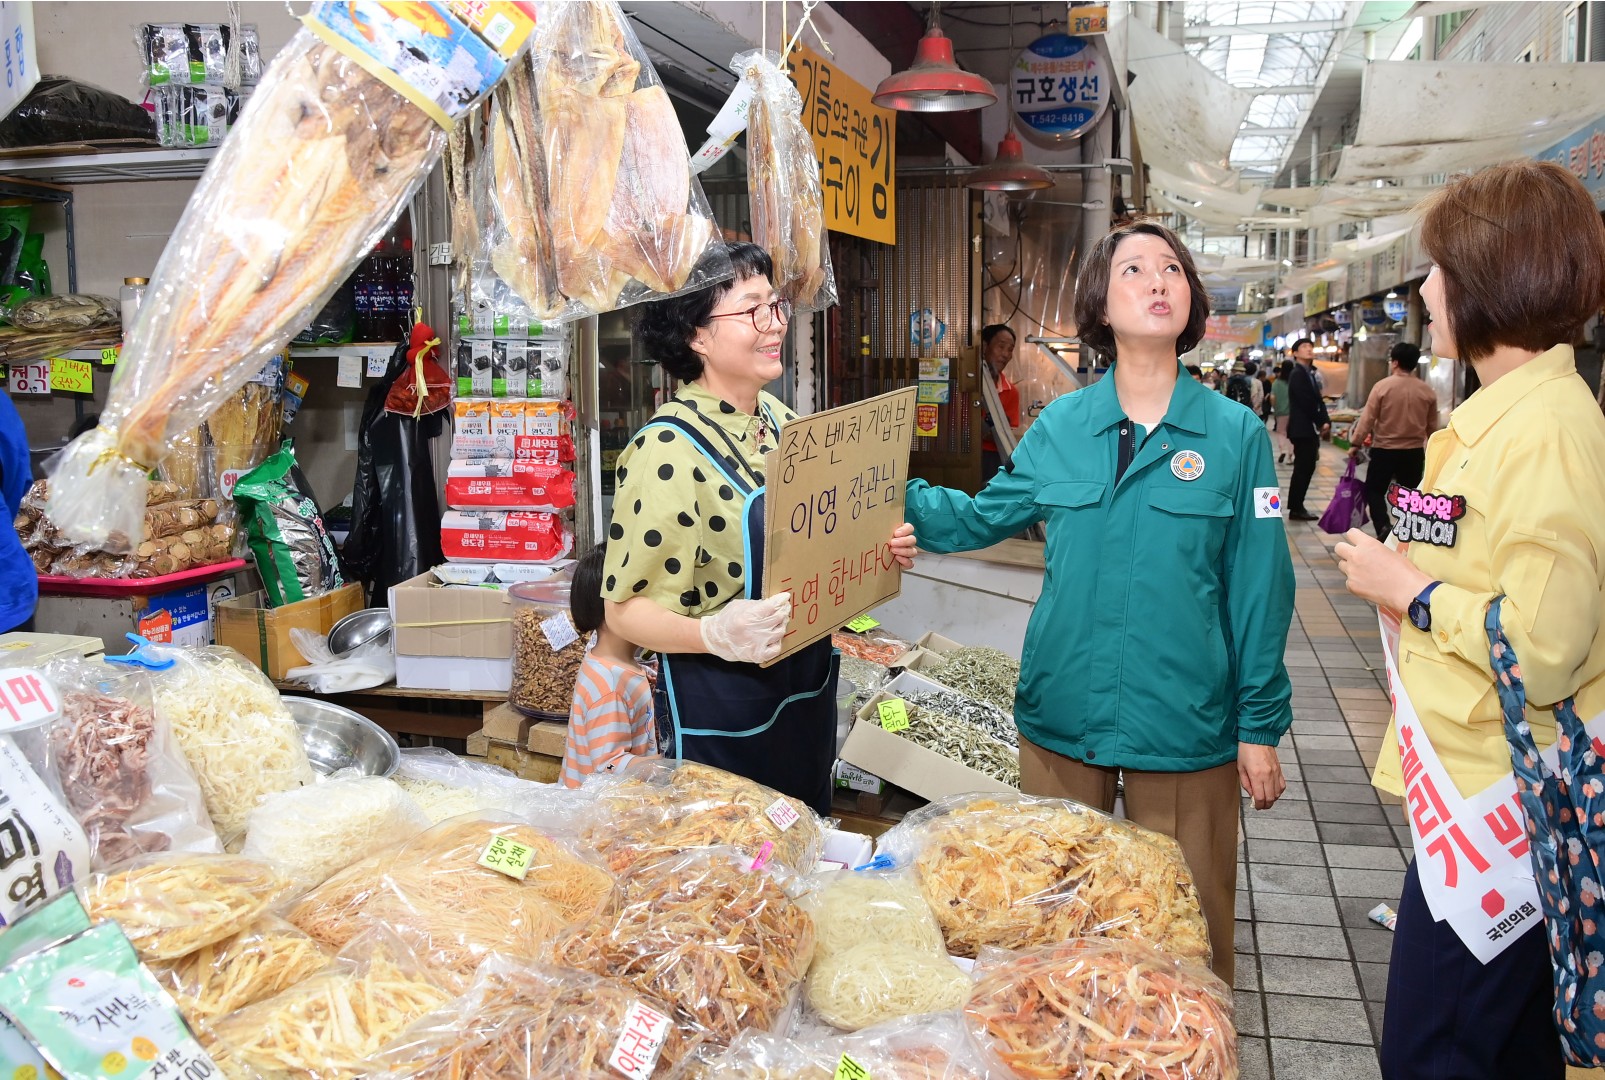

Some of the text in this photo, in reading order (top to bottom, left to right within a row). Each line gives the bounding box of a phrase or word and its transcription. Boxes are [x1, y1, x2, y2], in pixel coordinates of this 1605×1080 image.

[1016, 76, 1099, 104] 규호생선
[851, 109, 867, 159] 구운
[870, 114, 890, 220] 김
[12, 365, 49, 391] 청각
[49, 358, 91, 380] 표고버섯
[783, 397, 908, 485] 중소 벤처 기업부
[790, 458, 897, 539] 이영 장관님
[1396, 487, 1452, 520] 국회의원
[1391, 506, 1455, 546] 김미애
[828, 542, 883, 607] 합니다
[486, 836, 509, 866] 오징어
[506, 844, 527, 868] 실채
[1486, 901, 1537, 942] 국민의힘
[617, 1005, 664, 1072] 아귀채
[149, 1047, 189, 1079] 자반
